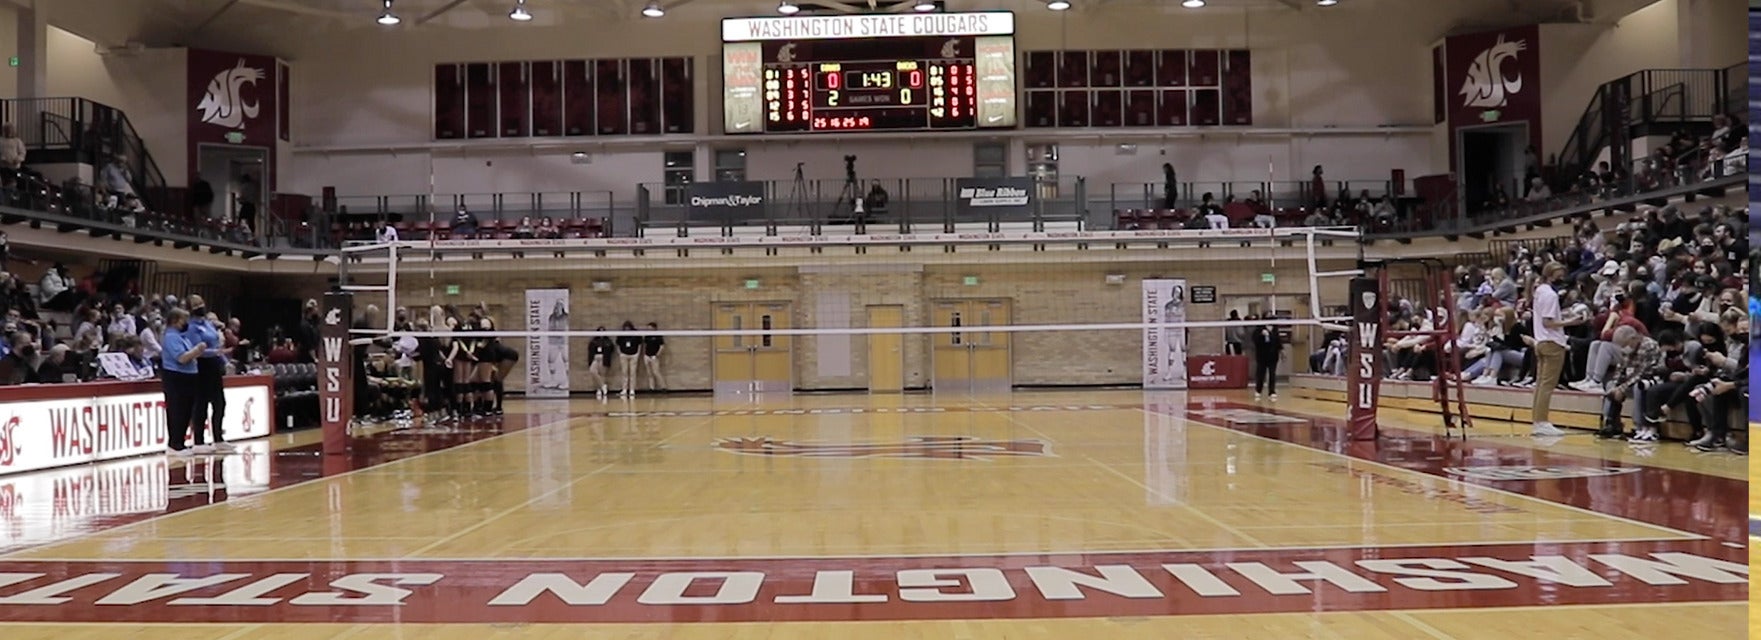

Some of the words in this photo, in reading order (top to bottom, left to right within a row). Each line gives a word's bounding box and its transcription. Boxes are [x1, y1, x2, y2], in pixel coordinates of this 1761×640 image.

[748, 18, 853, 37] WASHINGTON
[861, 17, 906, 35] STATE
[913, 15, 988, 34] COUGARS
[801, 68, 808, 78] 5
[828, 73, 838, 88] 0
[862, 72, 891, 88] 1:43
[910, 71, 920, 86] 0
[828, 90, 839, 106] 2
[900, 88, 911, 104] 0
[814, 118, 826, 128] 25
[842, 117, 855, 127] 25
[691, 195, 762, 207] Chipman&Taylor
[1147, 290, 1158, 316] STATE
[530, 300, 541, 326] STATE
[1358, 322, 1378, 408] WSU
[324, 337, 342, 422] WSU
[49, 401, 168, 458] WASHINGTO
[487, 551, 1749, 606] WASHINGTON
[0, 572, 444, 605] STAT
